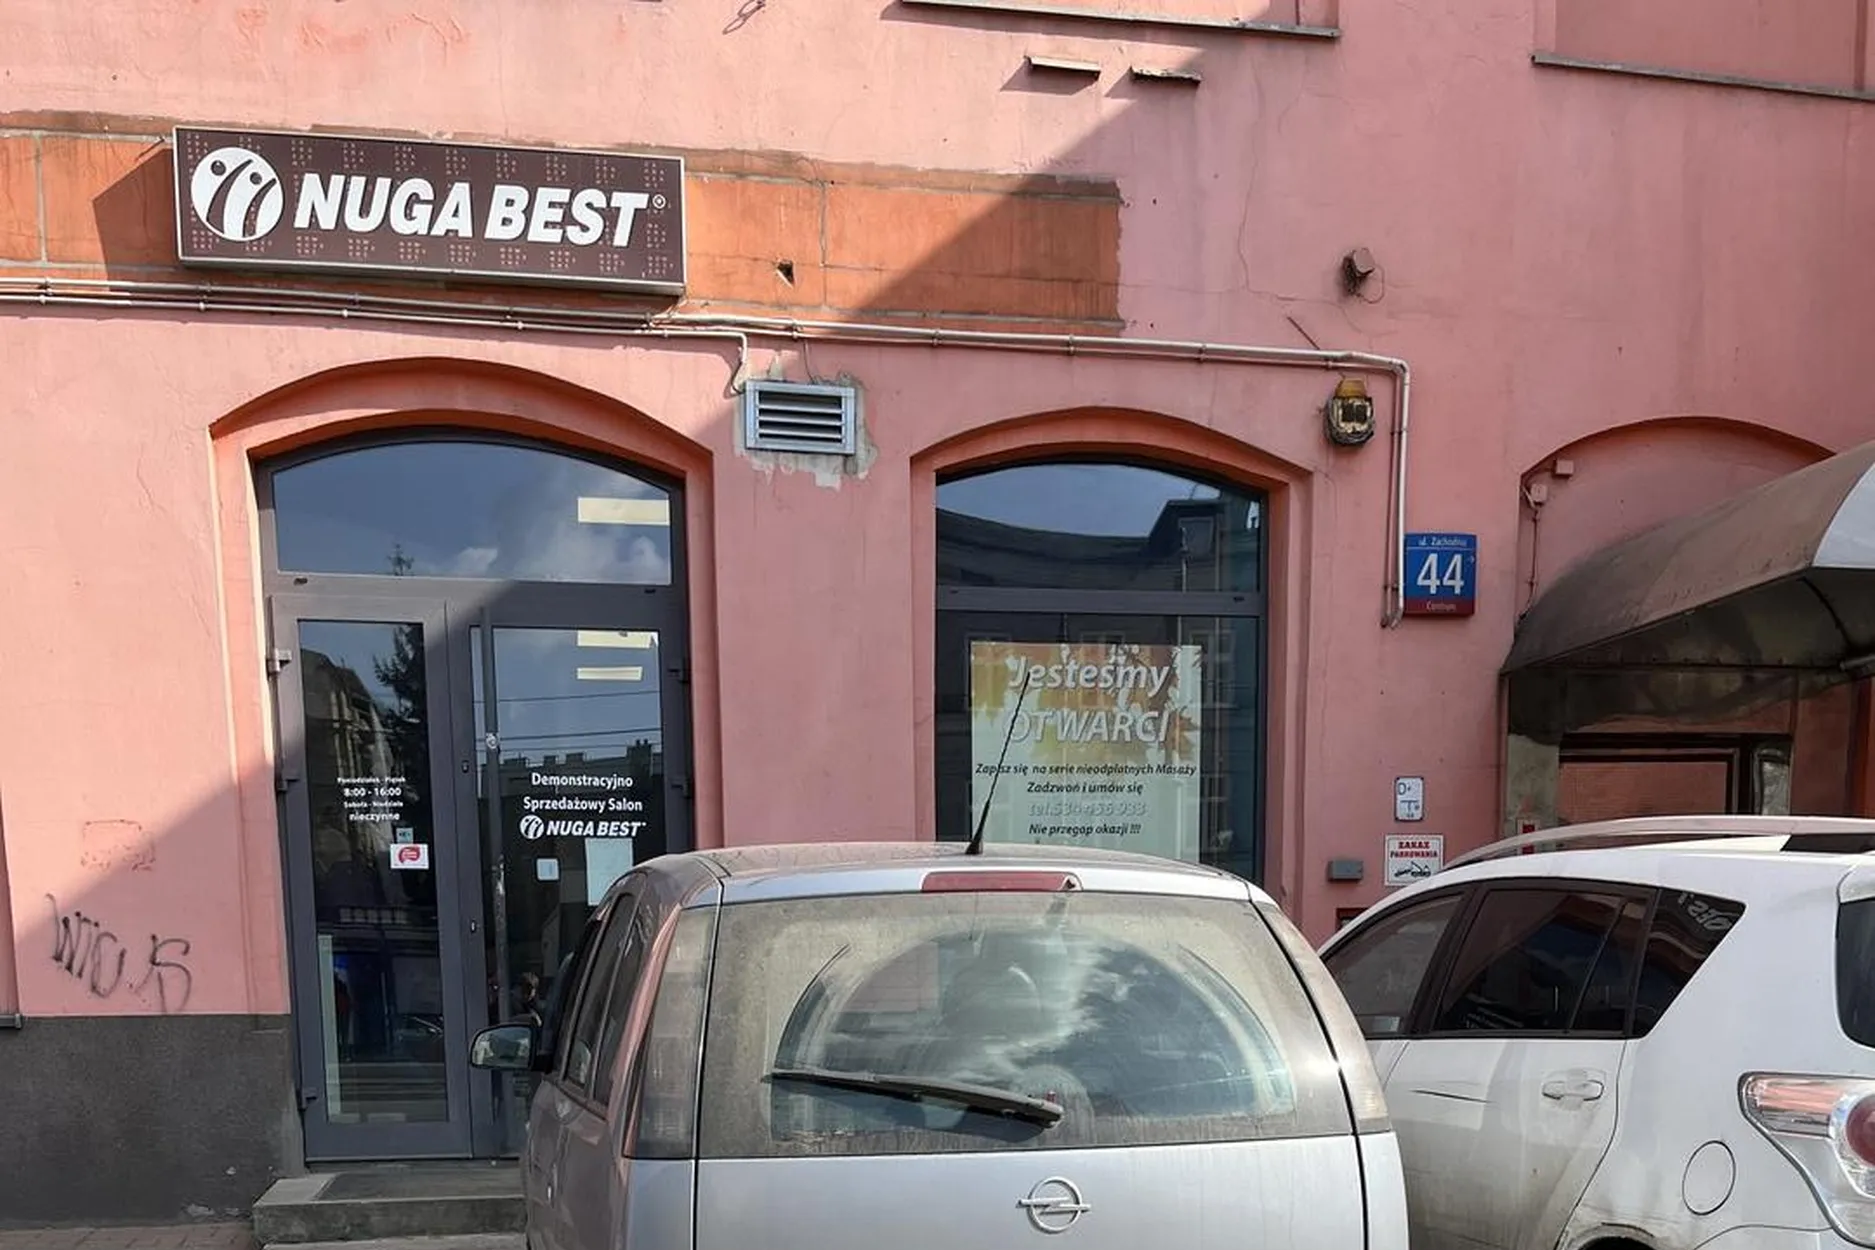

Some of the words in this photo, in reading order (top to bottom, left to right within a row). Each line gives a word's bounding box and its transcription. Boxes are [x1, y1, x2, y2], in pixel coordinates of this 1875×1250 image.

[292, 172, 474, 238] NUGA
[484, 184, 650, 247] BEST
[1416, 552, 1465, 595] 44
[1005, 711, 1171, 742] OTWARCI
[975, 763, 1011, 776] Zapsz
[1014, 763, 1029, 776] się
[1033, 765, 1047, 775] na
[1049, 763, 1075, 775] serie
[531, 772, 633, 790] Demonstracyjno
[1088, 781, 1125, 794] umów
[1127, 781, 1144, 795] się
[374, 787, 402, 797] 16:00
[523, 796, 606, 813] Sprzedażowy
[608, 797, 643, 811] Salon
[546, 820, 595, 836] NUGA
[596, 821, 642, 837] BEST
[1029, 823, 1048, 835] Nie
[1048, 824, 1093, 838] przegap
[1095, 823, 1128, 837] okazji
